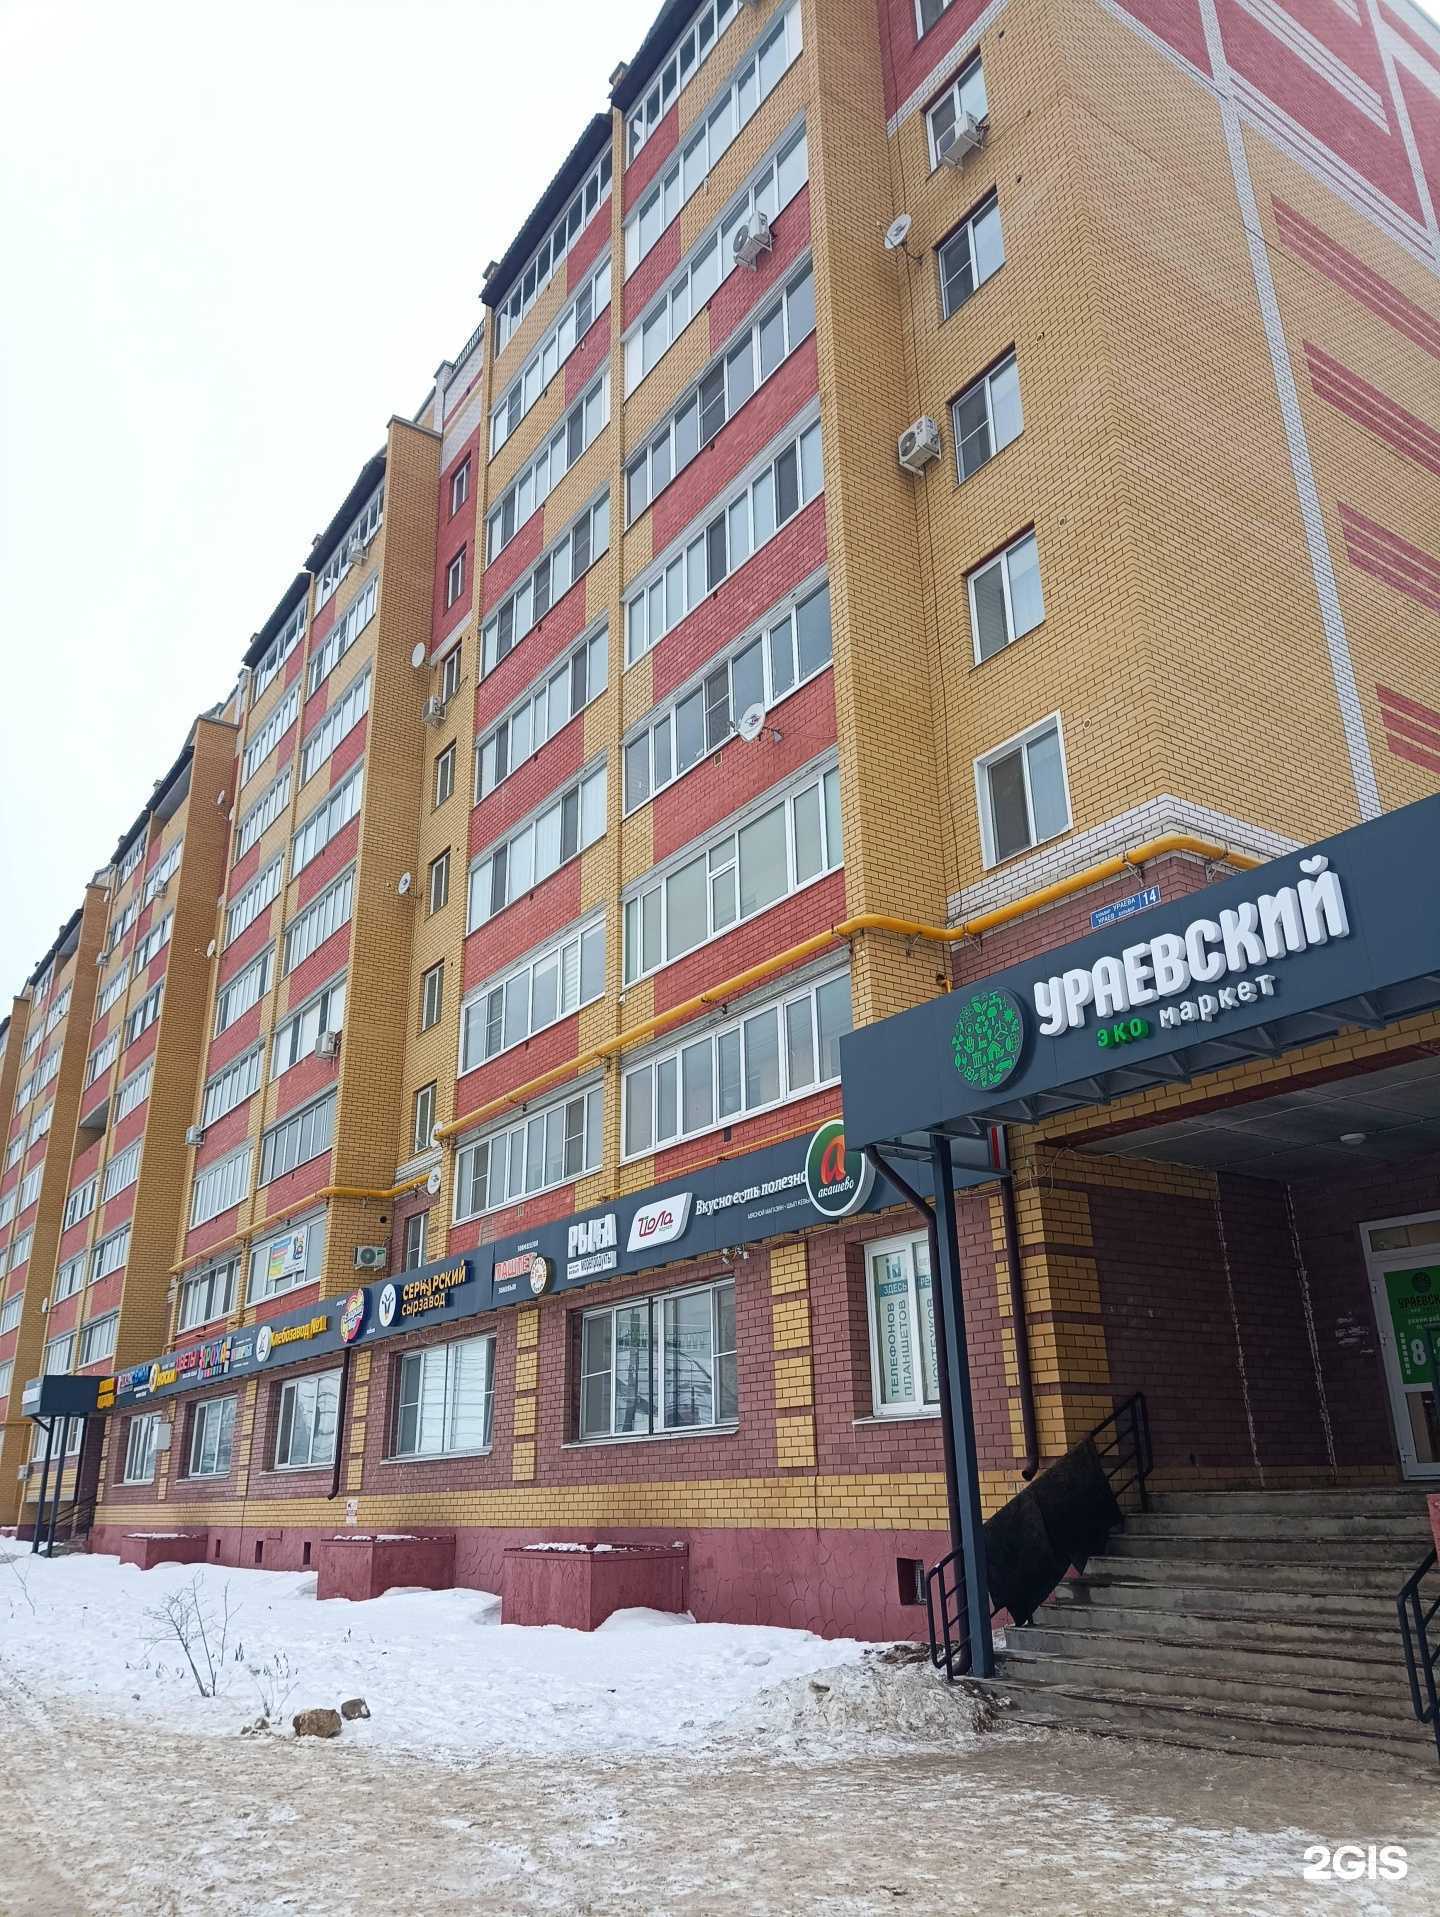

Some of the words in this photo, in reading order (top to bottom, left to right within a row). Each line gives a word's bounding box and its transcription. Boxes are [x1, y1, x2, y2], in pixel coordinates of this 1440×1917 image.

[1113, 897, 1136, 911] УРАЕВА
[1142, 888, 1157, 904] 14
[1034, 854, 1349, 1037] УРАЕВСКИЙ
[1159, 974, 1276, 1029] маркет
[695, 1191, 734, 1217] Вкусно
[733, 1186, 761, 1203] есть
[761, 1170, 807, 1195] полезно
[817, 1176, 855, 1198] акашево
[568, 1213, 618, 1258] РЫБА
[401, 1293, 446, 1318] сырзавод
[883, 1282, 908, 1296] ЗДЕСЬ
[887, 1302, 900, 1396] ТЕЛЕФОНОВ
[899, 1300, 912, 1396] ПЛАНШЕТОВ
